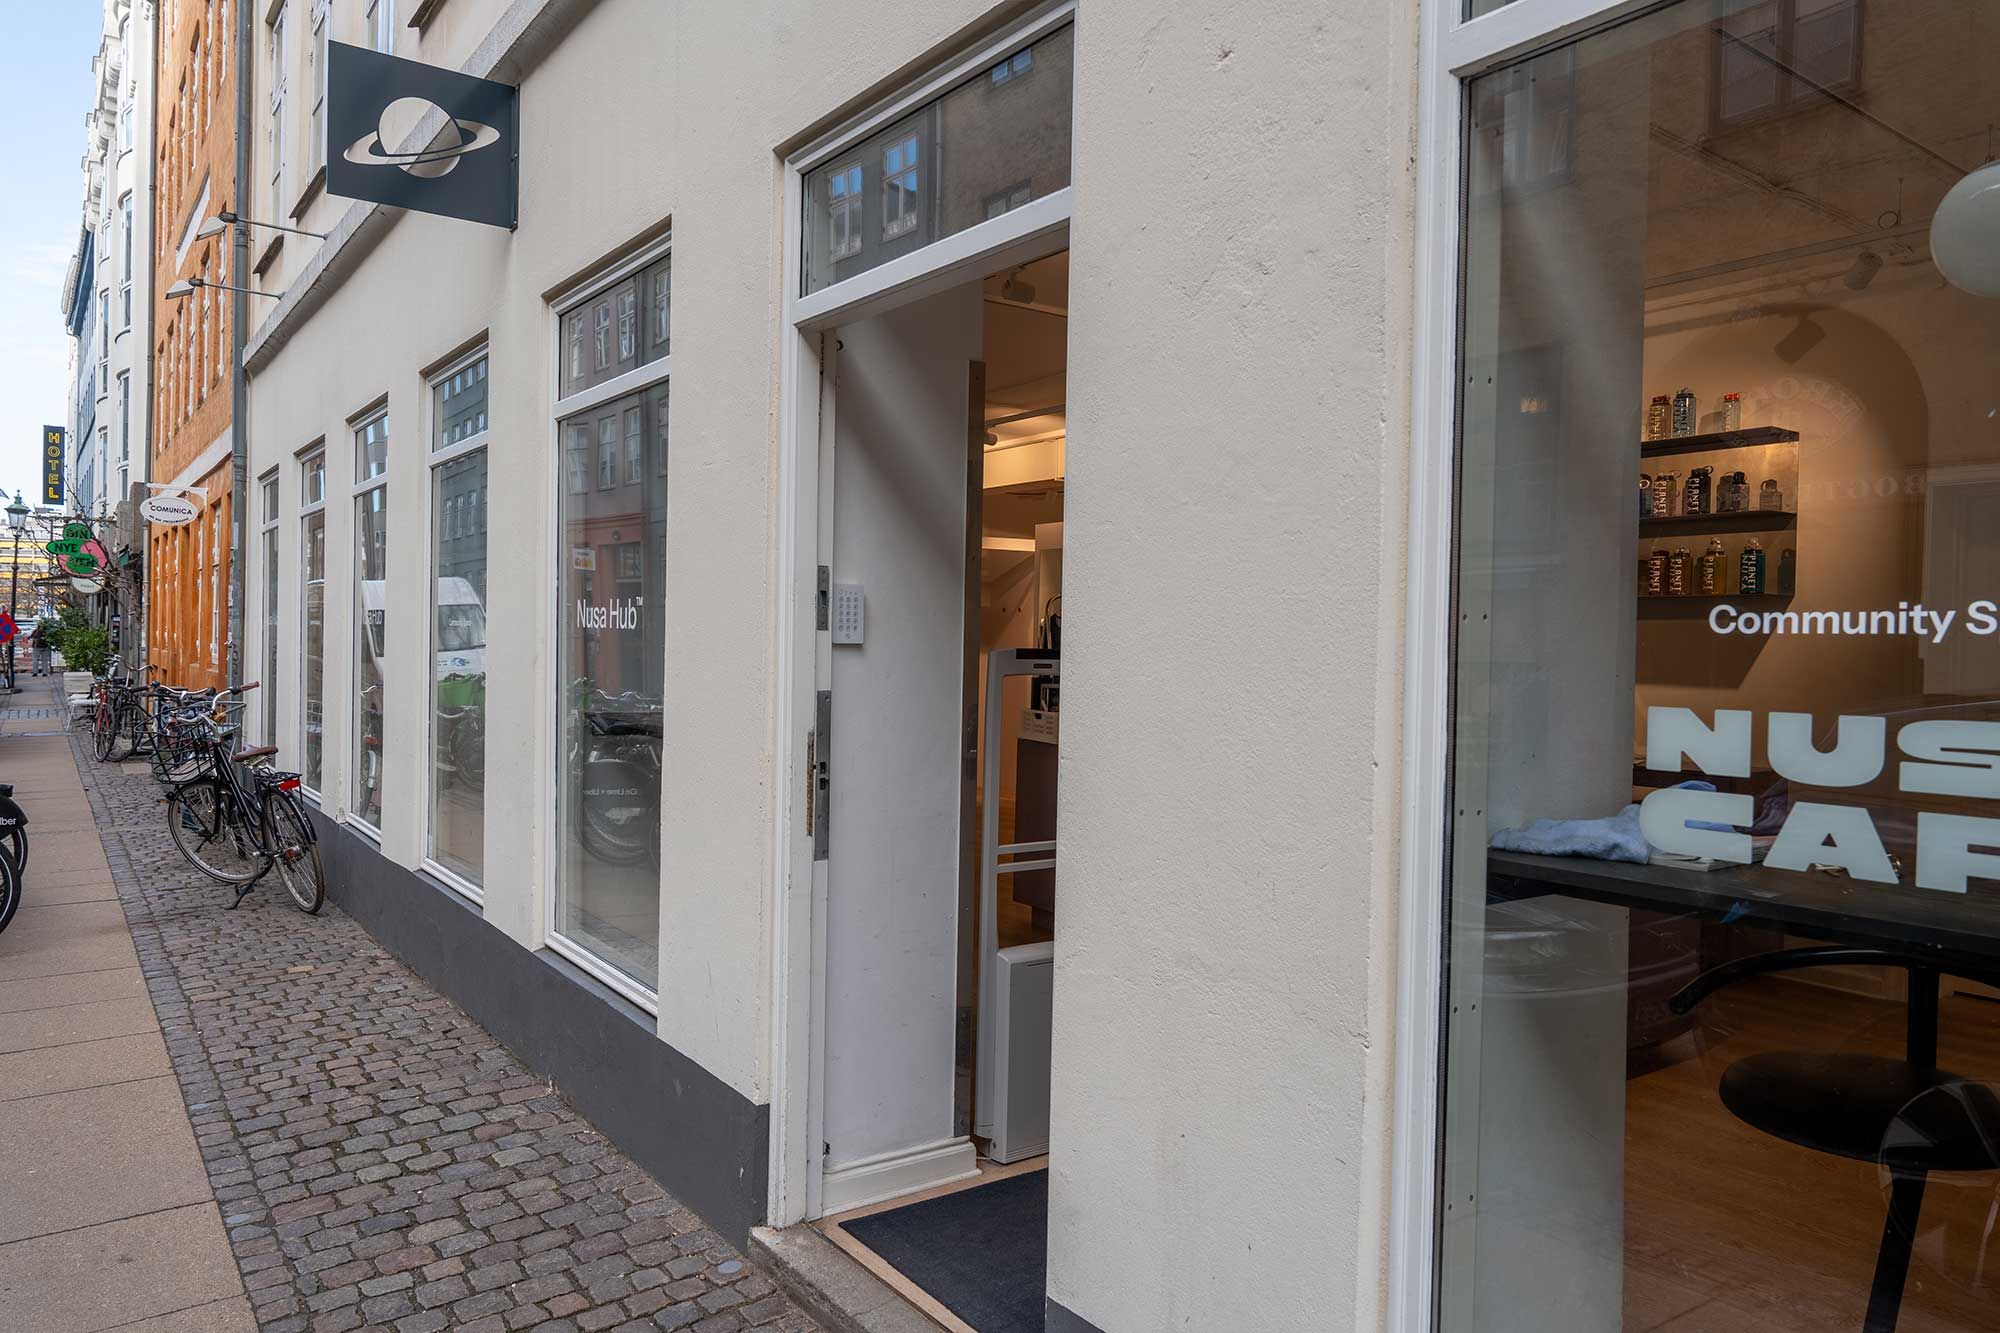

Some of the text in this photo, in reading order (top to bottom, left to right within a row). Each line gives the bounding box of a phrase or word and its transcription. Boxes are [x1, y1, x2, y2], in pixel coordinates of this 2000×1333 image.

[48, 432, 60, 499] HOTEL
[150, 504, 193, 515] COMUNICA
[1659, 480, 1667, 513] PLANET
[1692, 478, 1700, 511] PLANET
[54, 543, 78, 552] NYE
[1652, 559, 1661, 592] PLANET
[1674, 558, 1682, 591] PLANET
[1706, 556, 1714, 590] PLANET
[1748, 555, 1756, 589] PLANET
[577, 599, 607, 629] Nusa
[1708, 601, 1956, 643] Community
[1646, 706, 2000, 800] NUS
[1639, 788, 2000, 894] CAF
